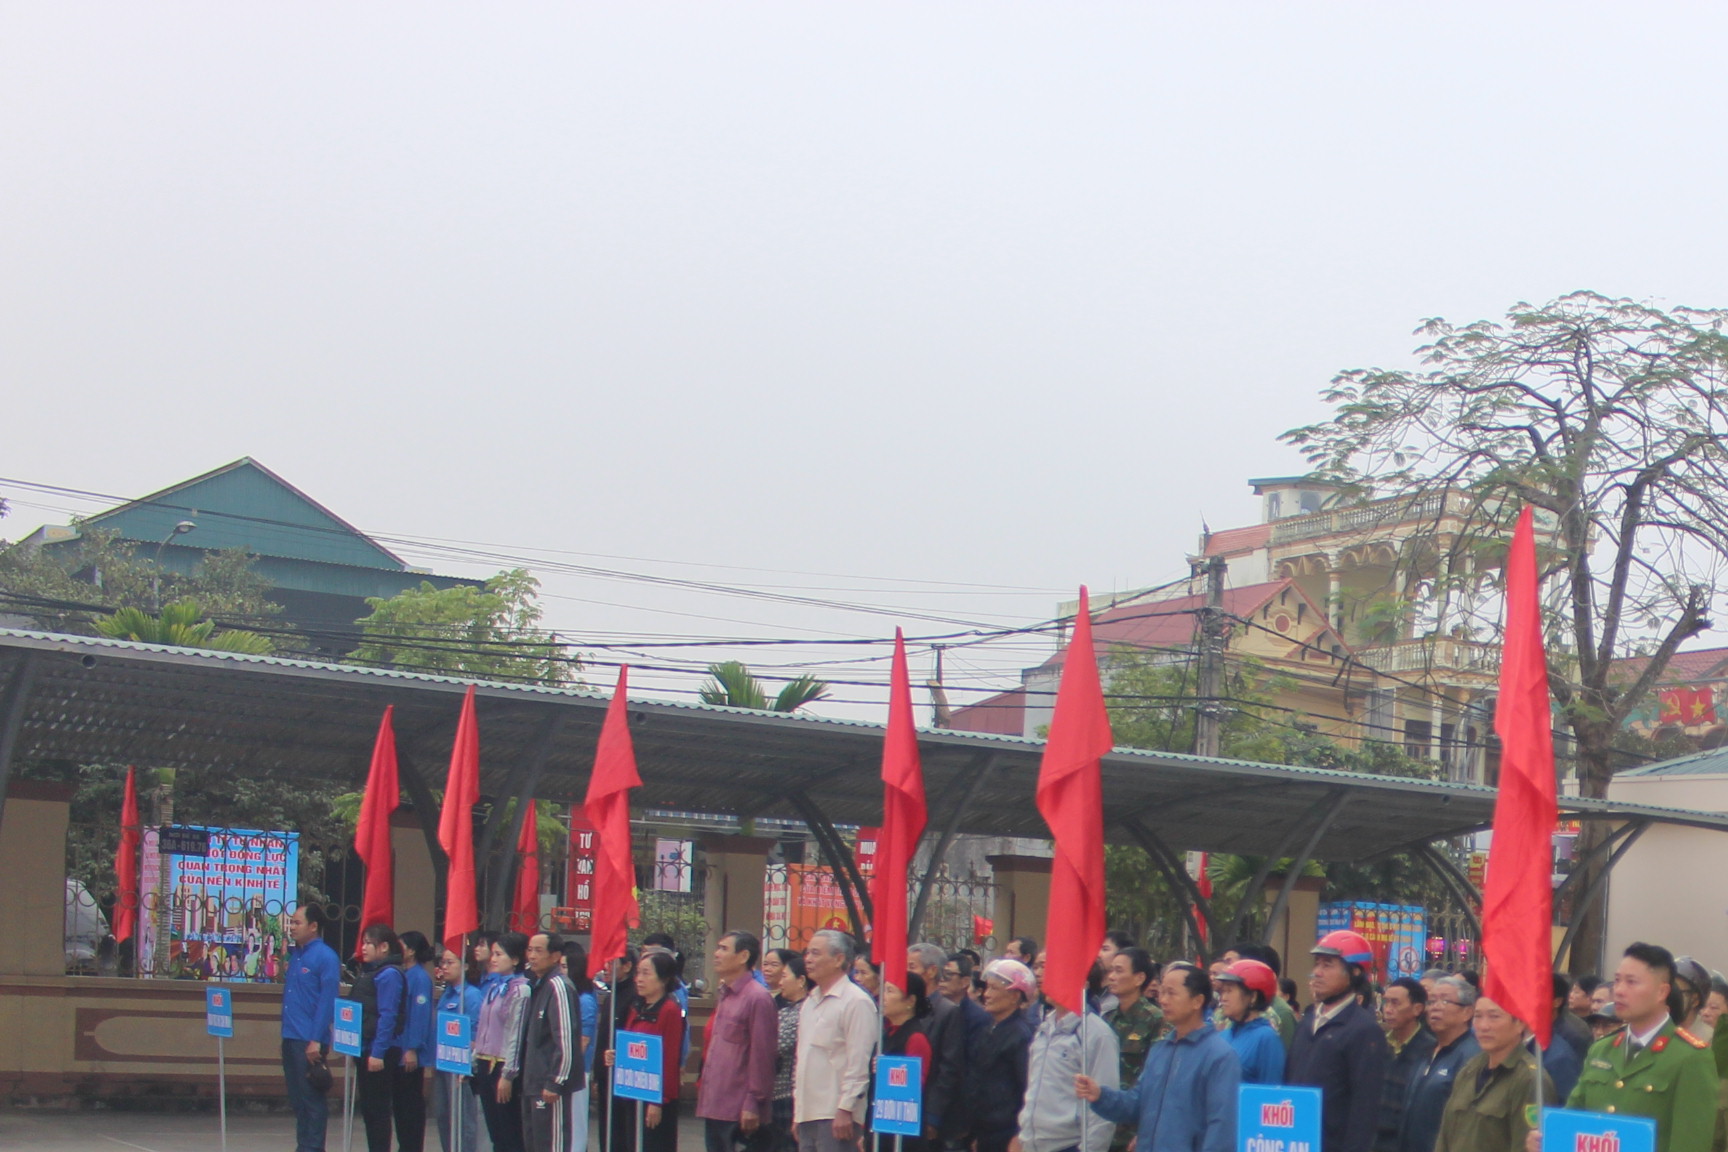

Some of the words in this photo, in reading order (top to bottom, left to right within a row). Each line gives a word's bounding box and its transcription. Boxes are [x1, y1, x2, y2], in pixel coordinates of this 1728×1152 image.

[580, 832, 592, 848] TƯ
[628, 1040, 648, 1060] KHỐI
[888, 1063, 908, 1087] KHỐI
[1261, 1099, 1294, 1128] KHỐI
